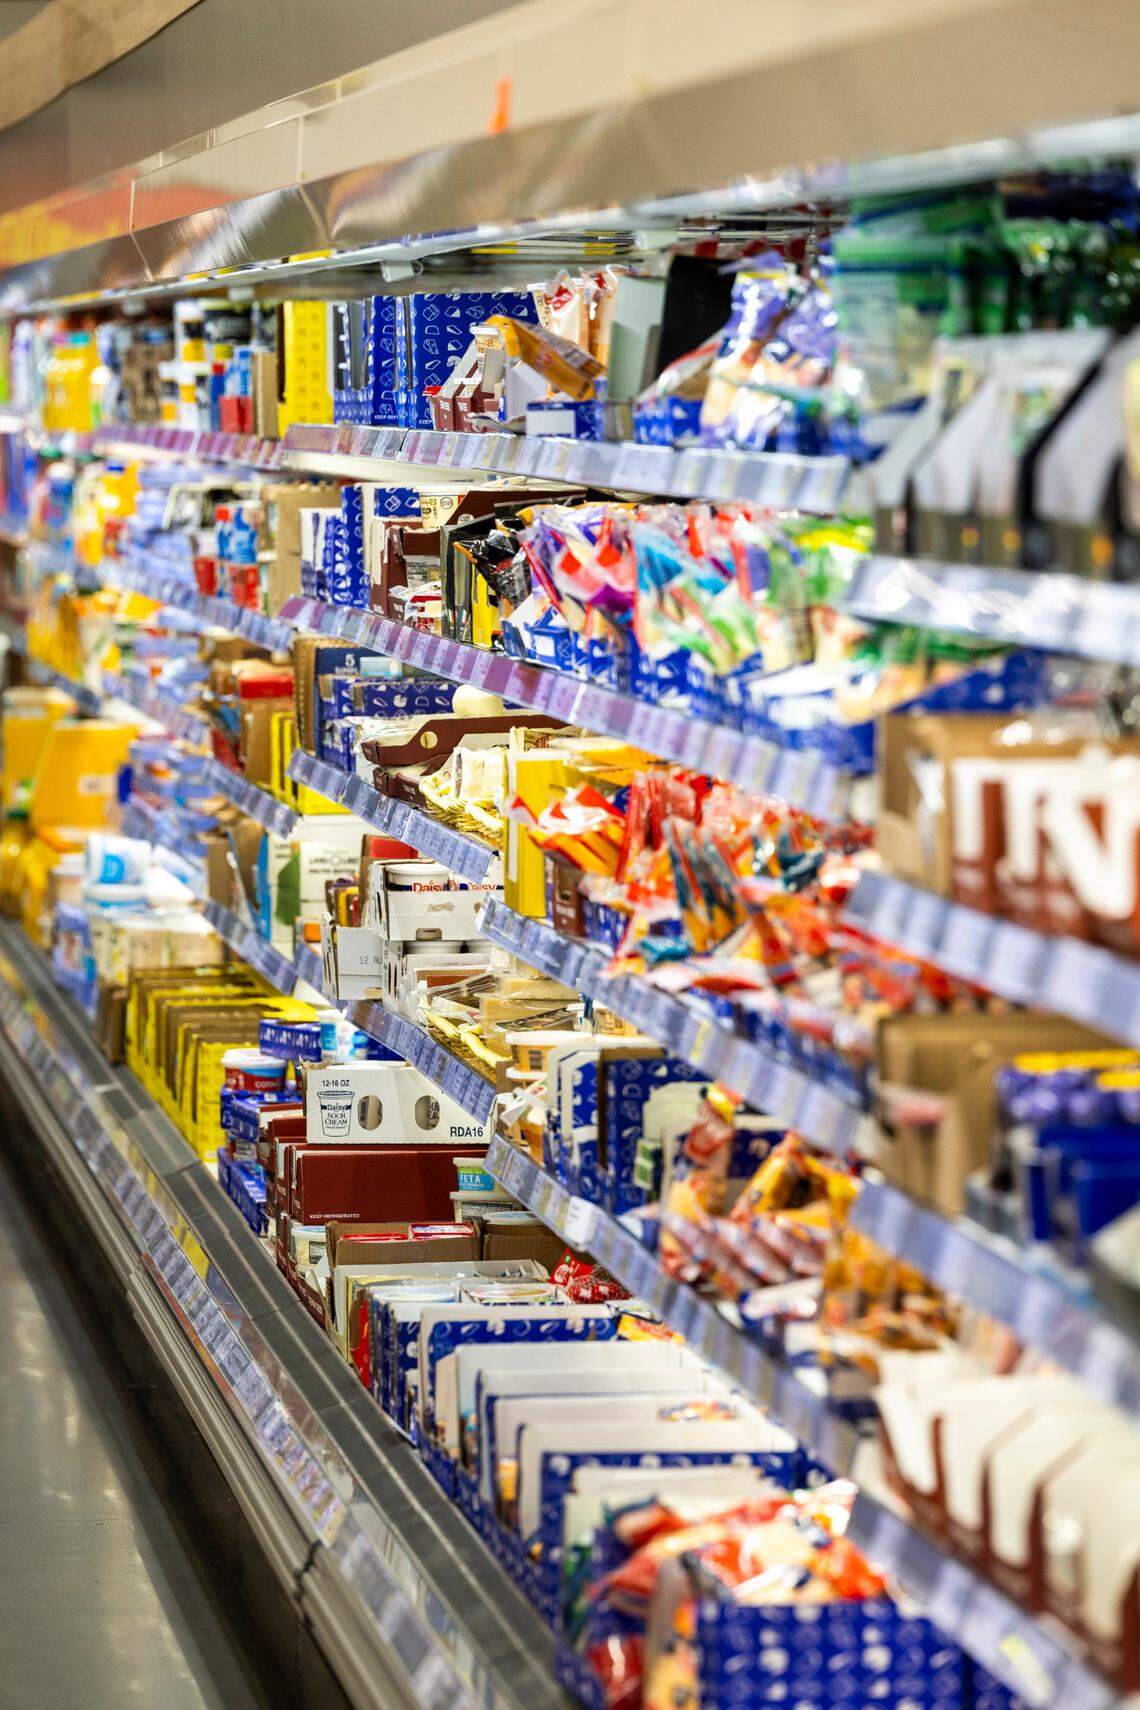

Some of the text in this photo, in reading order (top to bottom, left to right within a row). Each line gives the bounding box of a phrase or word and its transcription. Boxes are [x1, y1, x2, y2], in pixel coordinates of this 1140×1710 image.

[322, 1079, 350, 1087] 12-16 OZ
[327, 1103, 346, 1111] Daisy
[450, 1126, 484, 1138] RDA16
